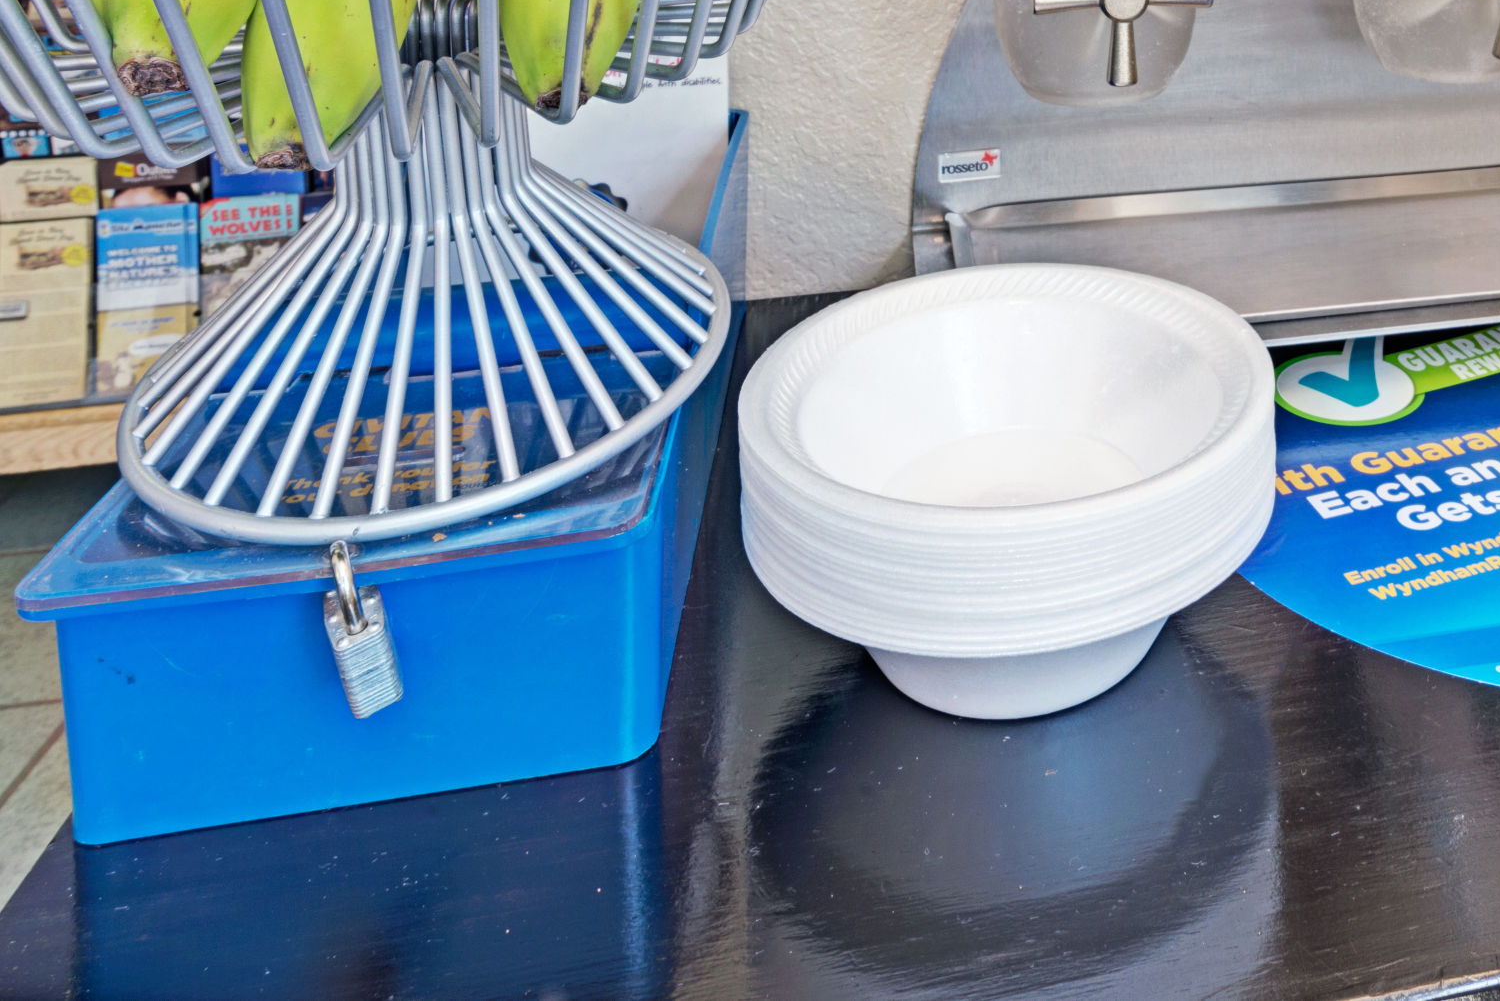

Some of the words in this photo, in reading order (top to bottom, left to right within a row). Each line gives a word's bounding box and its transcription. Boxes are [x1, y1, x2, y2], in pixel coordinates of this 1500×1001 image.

[941, 160, 989, 174] rosseto
[211, 208, 240, 222] SEE
[247, 204, 281, 218] THE
[208, 218, 281, 236] WOLVES
[1274, 463, 1346, 496] ith
[1306, 473, 1442, 519] Each
[1343, 556, 1417, 585] Enroll
[1415, 549, 1444, 567] in
